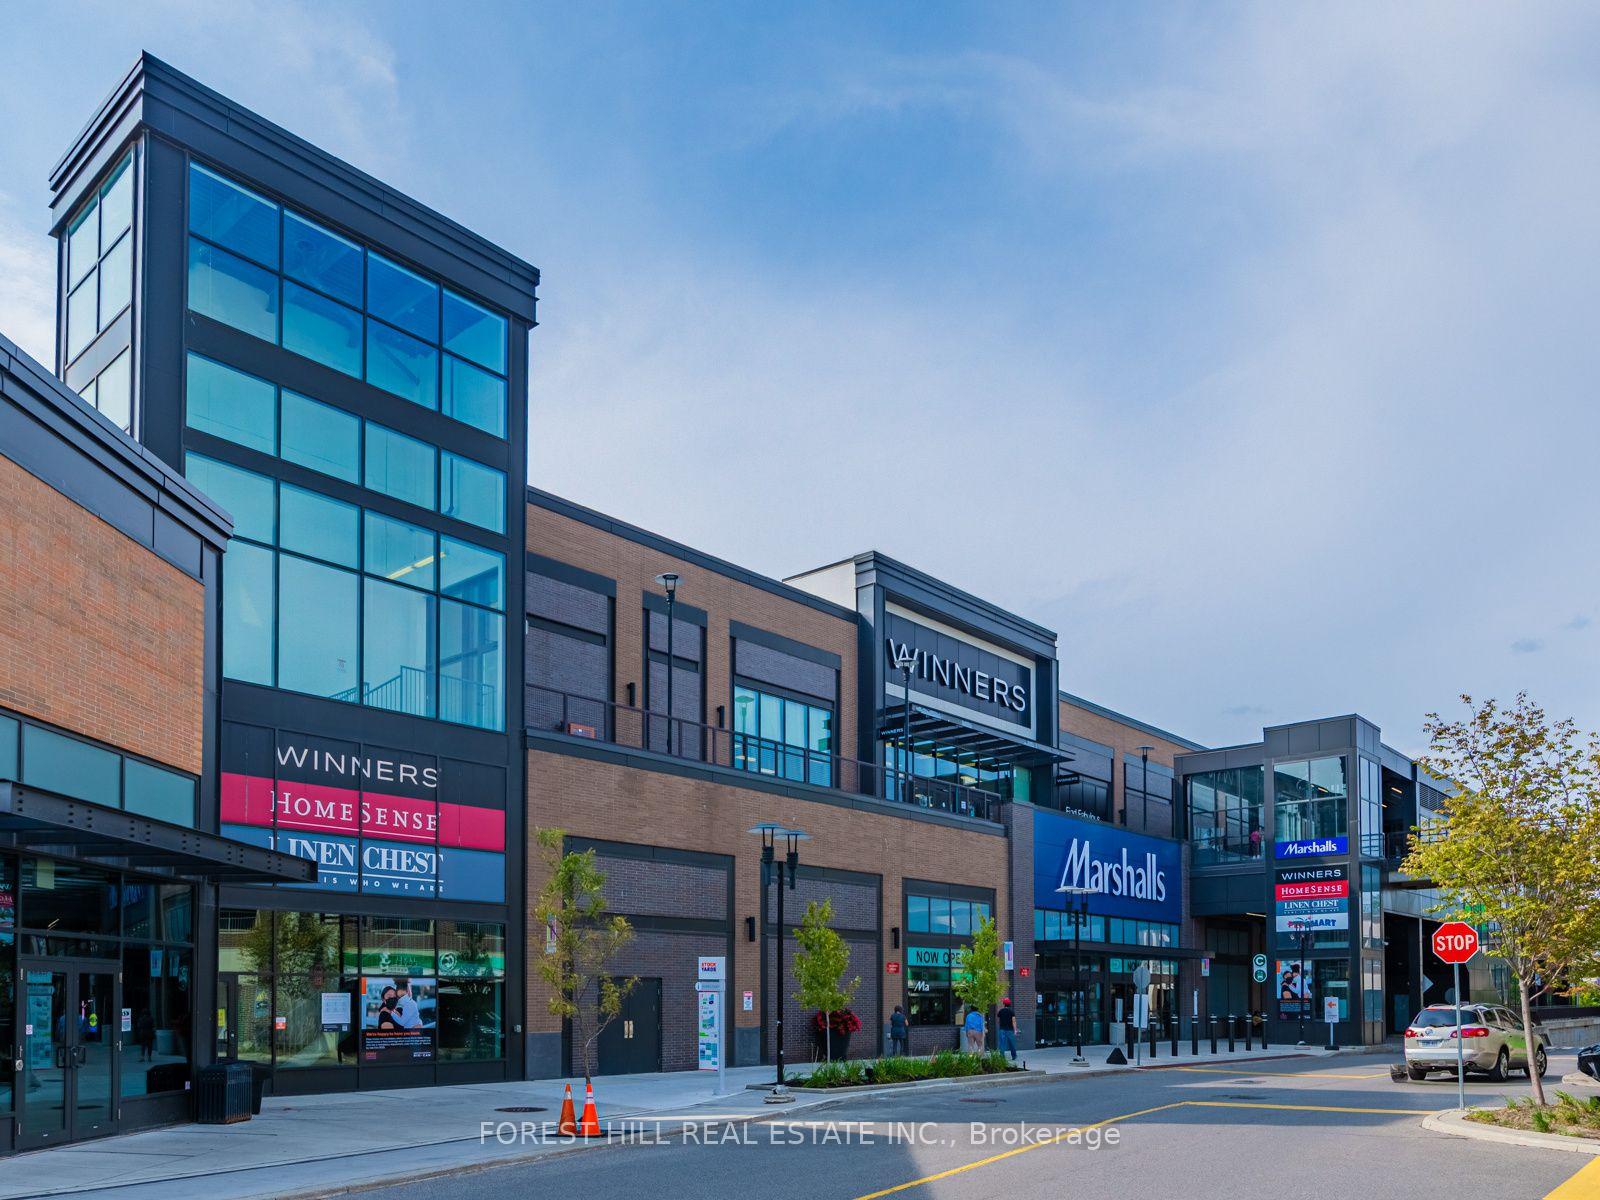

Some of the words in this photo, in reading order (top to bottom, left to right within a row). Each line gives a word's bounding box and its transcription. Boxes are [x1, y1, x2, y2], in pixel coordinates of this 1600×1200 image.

[889, 638, 1026, 712] WINNERS
[881, 727, 904, 736] WINNERS
[277, 745, 438, 788] WINNERS
[270, 790, 439, 832] HOMESENSE
[1283, 840, 1337, 856] Marshalls
[363, 847, 444, 875] CHEST
[1060, 837, 1166, 902] Marshalls
[1281, 869, 1342, 881] WINNERS
[323, 876, 338, 884] IS
[350, 878, 381, 888] WHO
[391, 882, 409, 890] WE
[419, 884, 444, 893] ARE
[1281, 884, 1342, 895] HOMESENSE
[1284, 901, 1310, 909] LINEN
[1311, 899, 1339, 908] CHEST
[1436, 934, 1475, 952] STOP
[915, 951, 939, 964] NOW
